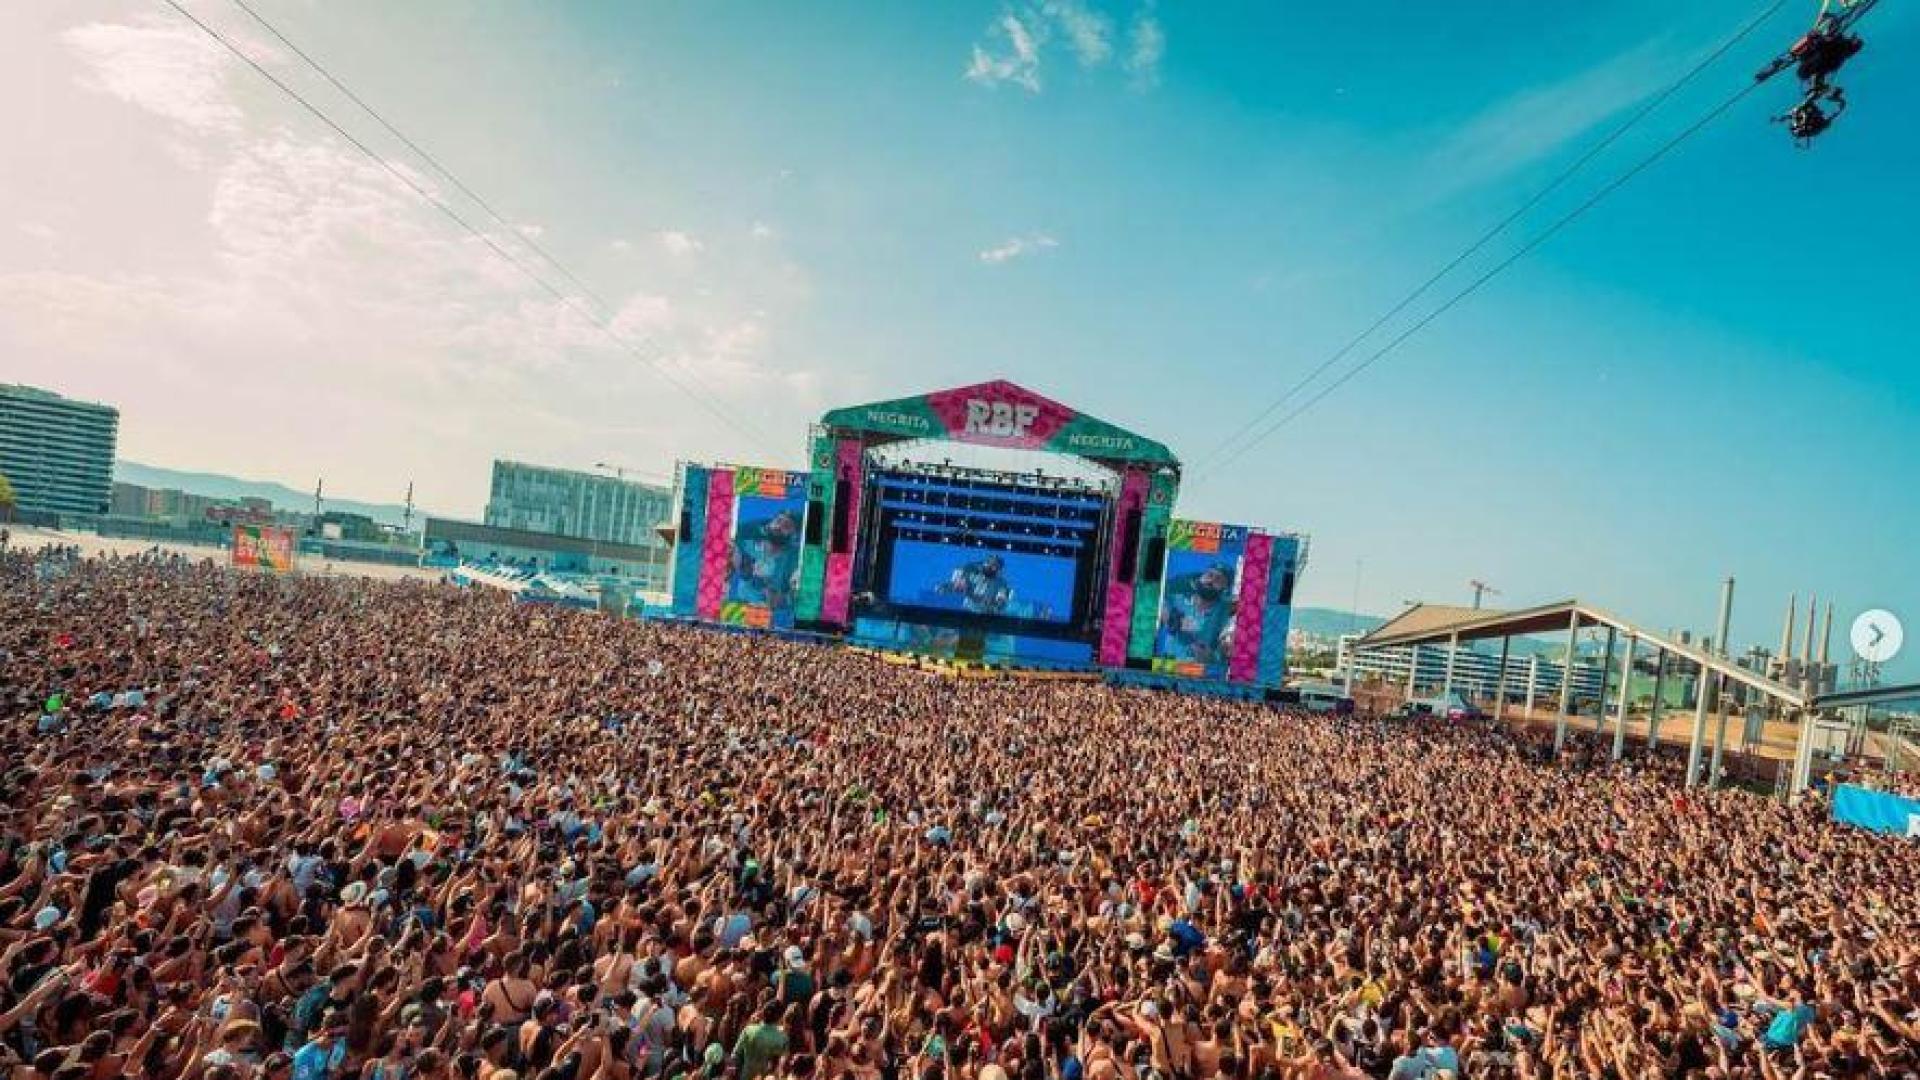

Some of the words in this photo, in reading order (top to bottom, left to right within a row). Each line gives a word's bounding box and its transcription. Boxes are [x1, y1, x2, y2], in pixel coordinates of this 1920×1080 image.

[867, 410, 930, 431] NEGRITA
[965, 399, 1038, 437] RBF
[1069, 433, 1133, 450] NEGRITA
